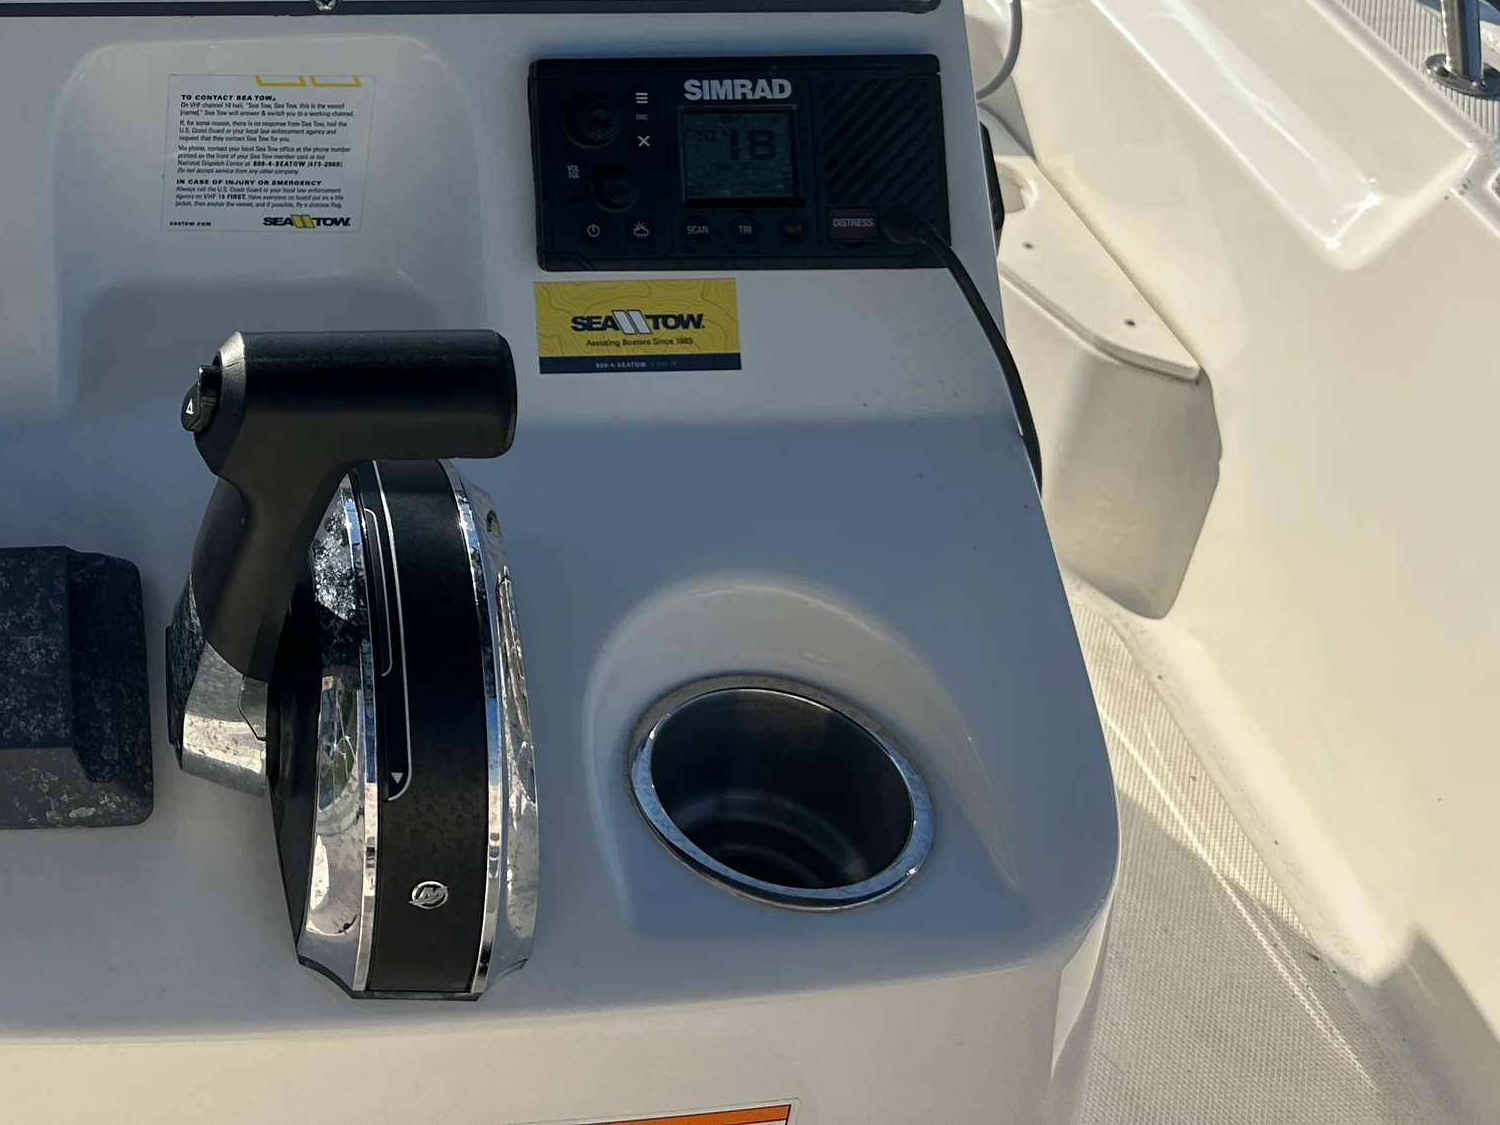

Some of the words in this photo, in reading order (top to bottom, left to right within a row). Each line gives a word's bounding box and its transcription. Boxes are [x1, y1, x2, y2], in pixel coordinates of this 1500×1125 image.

[683, 79, 792, 101] SIMRAD
[263, 217, 294, 226] SEA
[833, 217, 873, 228] DISTRESS
[686, 225, 708, 235] SCAN
[738, 225, 752, 234] TRI
[571, 316, 620, 332] SEA
[645, 314, 703, 330] TOW
[586, 339, 620, 347] Assisting
[622, 339, 651, 347] Boaters
[652, 338, 673, 346] Since
